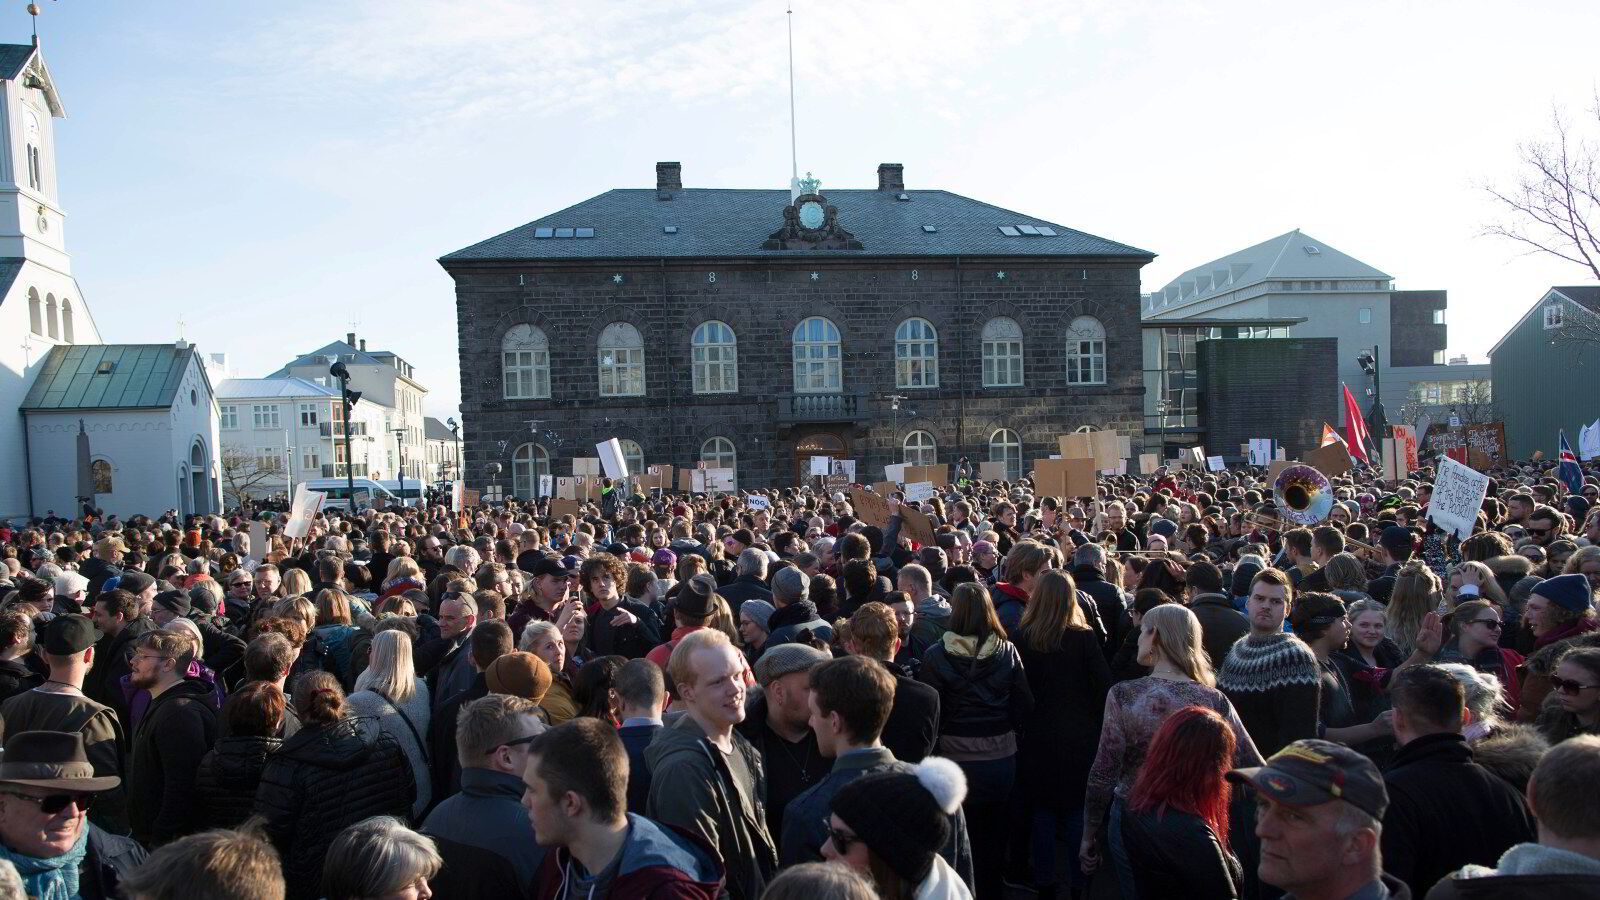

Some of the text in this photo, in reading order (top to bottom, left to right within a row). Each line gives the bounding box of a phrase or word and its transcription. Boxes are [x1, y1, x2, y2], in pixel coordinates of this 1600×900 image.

[519, 269, 1088, 285] 1 8 8 1
